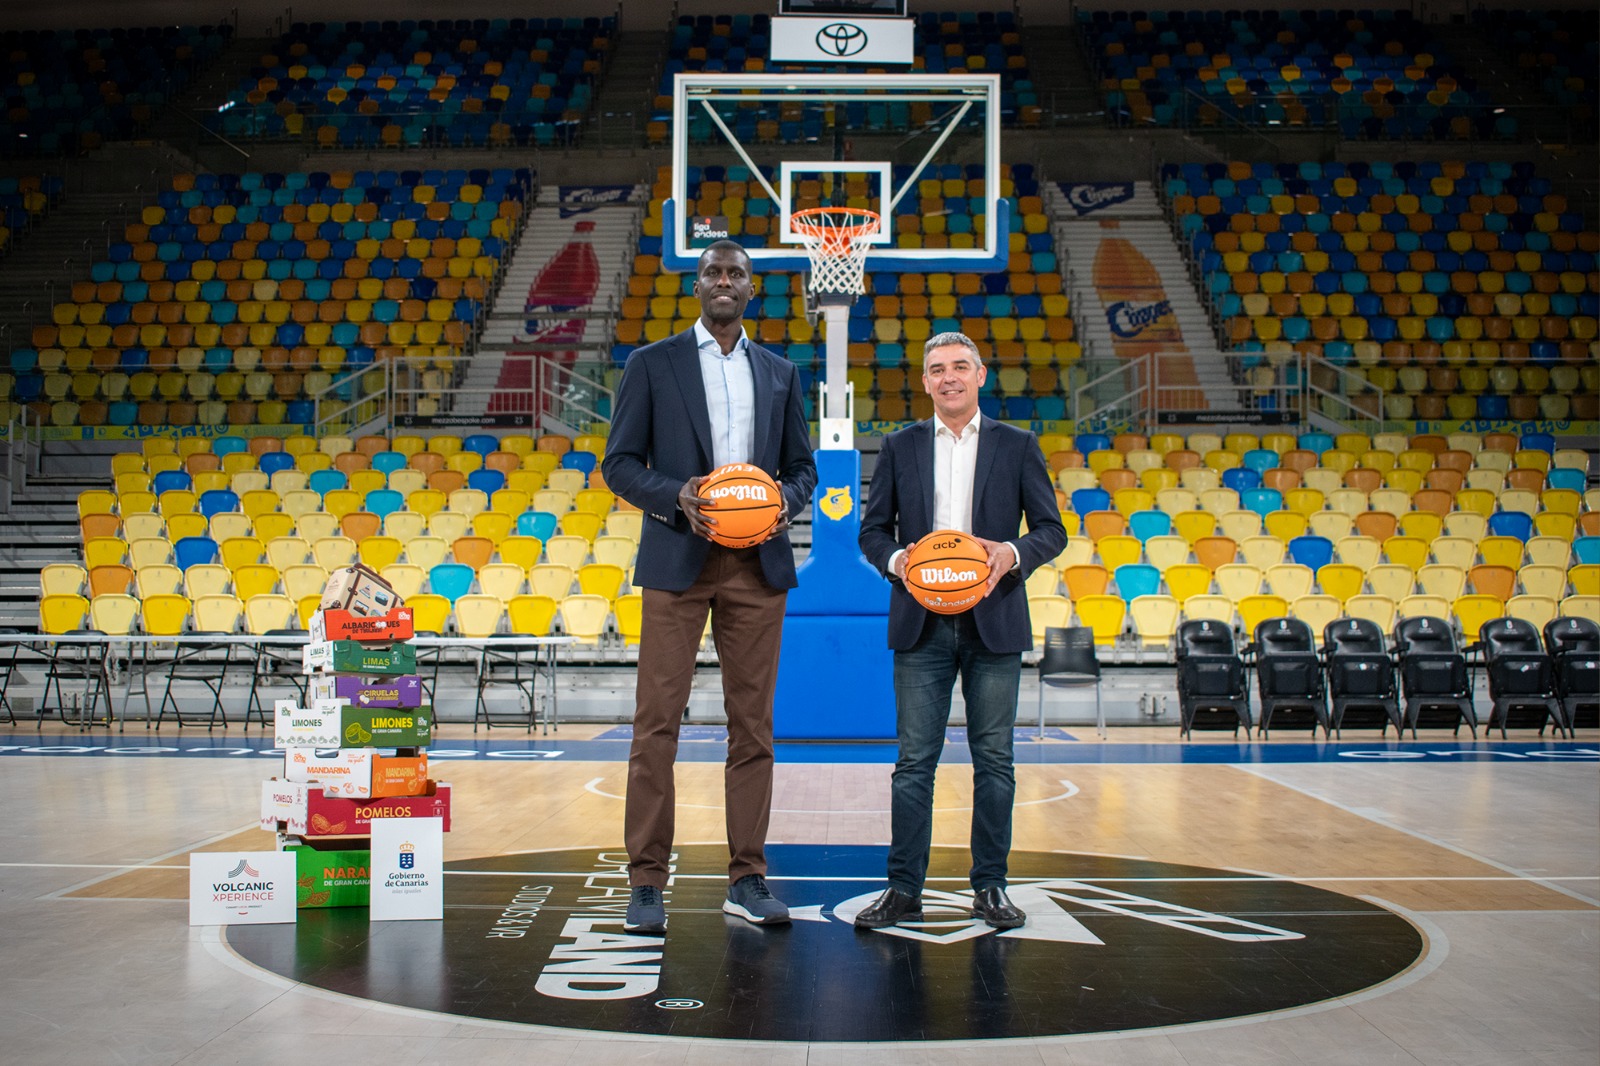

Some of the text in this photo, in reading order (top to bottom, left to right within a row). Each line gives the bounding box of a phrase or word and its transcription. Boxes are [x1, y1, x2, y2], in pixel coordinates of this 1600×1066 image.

[693, 222, 710, 231] liga
[693, 230, 728, 238] endesa
[431, 417, 496, 425] mezzobespoke.com
[709, 485, 768, 501] Wilson
[933, 541, 957, 550] acb
[920, 567, 977, 584] Wilson
[363, 657, 390, 666] LIMAS
[364, 689, 399, 697] CIRUELAS
[292, 719, 322, 727] LIMONES
[371, 717, 413, 728] LIMONES
[306, 766, 351, 775] MANDARINA
[386, 767, 416, 777] MANDARINA
[273, 793, 293, 803] POMELOS
[355, 806, 411, 818] POMELOS
[212, 881, 274, 892] VOLCANIC
[212, 892, 274, 902] XPERIENCE
[501, 885, 554, 918] STUDIOS
[485, 925, 530, 939] VR
